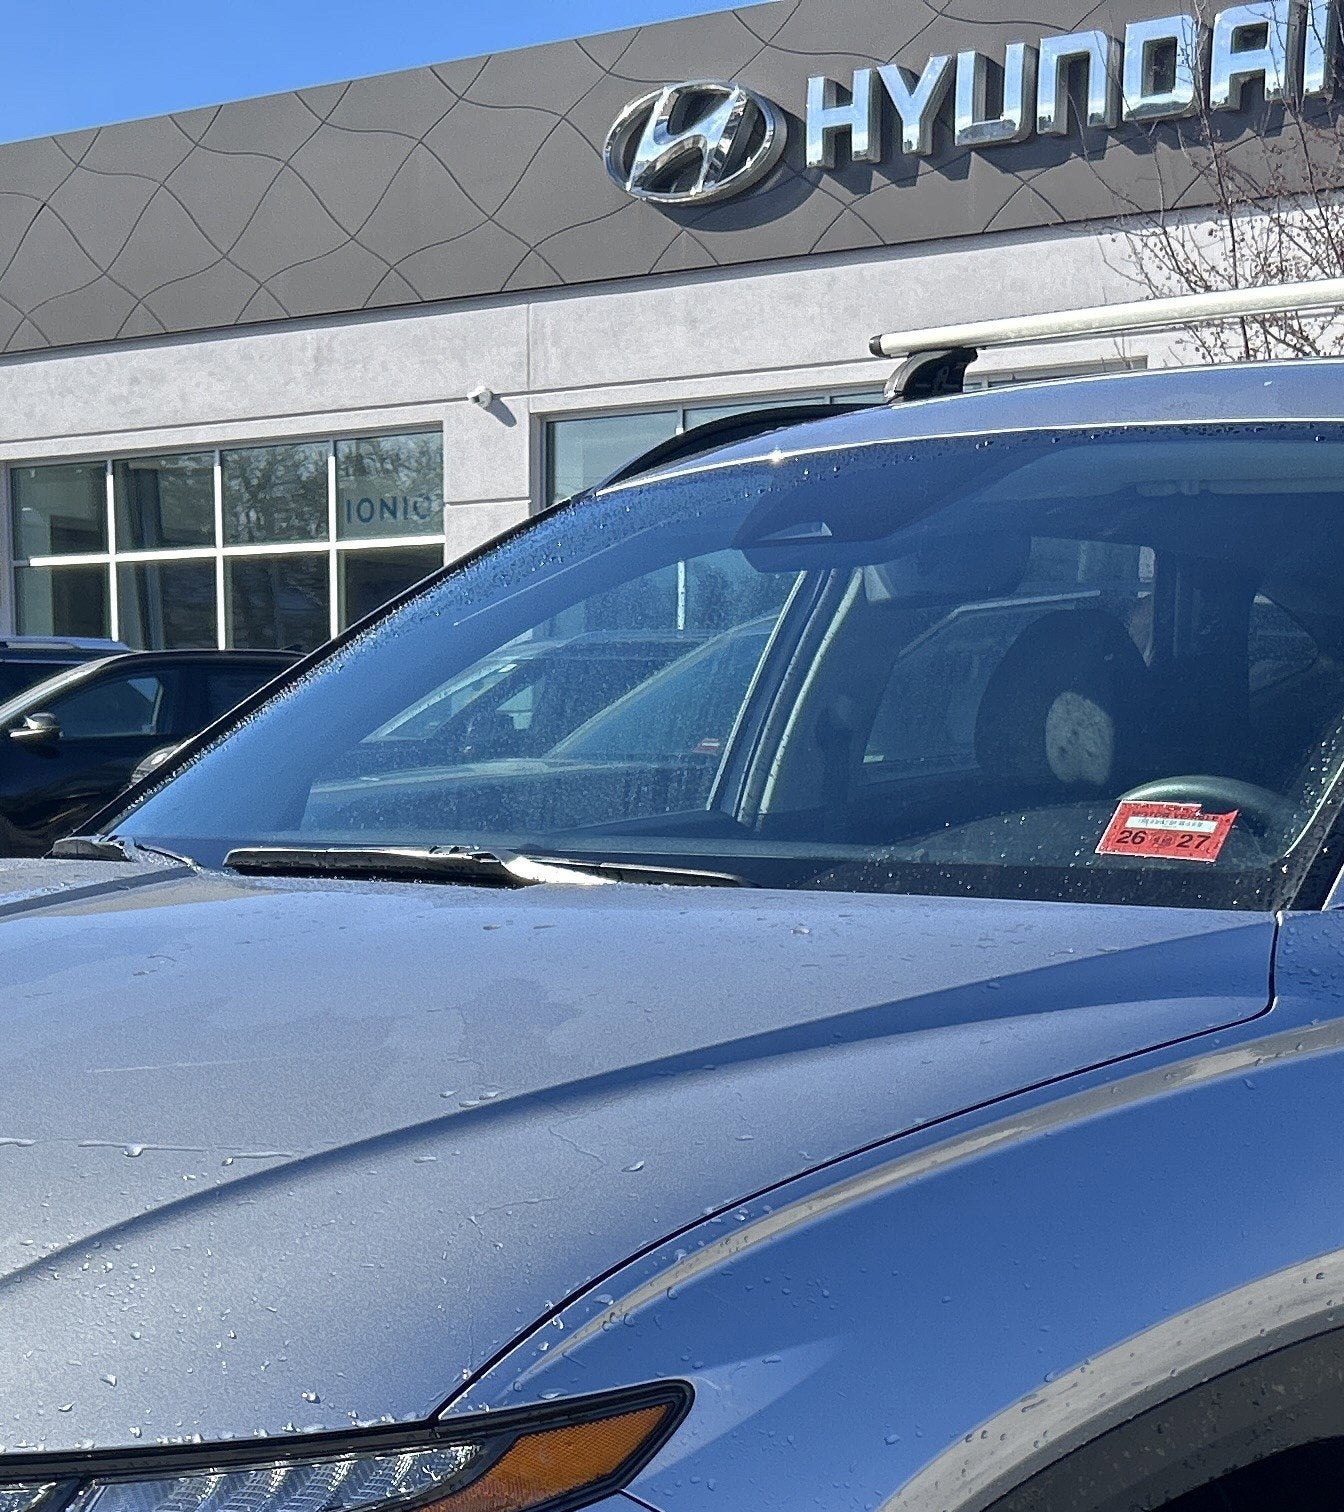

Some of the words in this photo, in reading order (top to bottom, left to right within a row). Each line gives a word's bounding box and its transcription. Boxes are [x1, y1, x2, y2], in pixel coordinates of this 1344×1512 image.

[805, 0, 1332, 170] HYUNDAI
[1116, 829, 1147, 845] 26
[1176, 833, 1212, 849] 27
